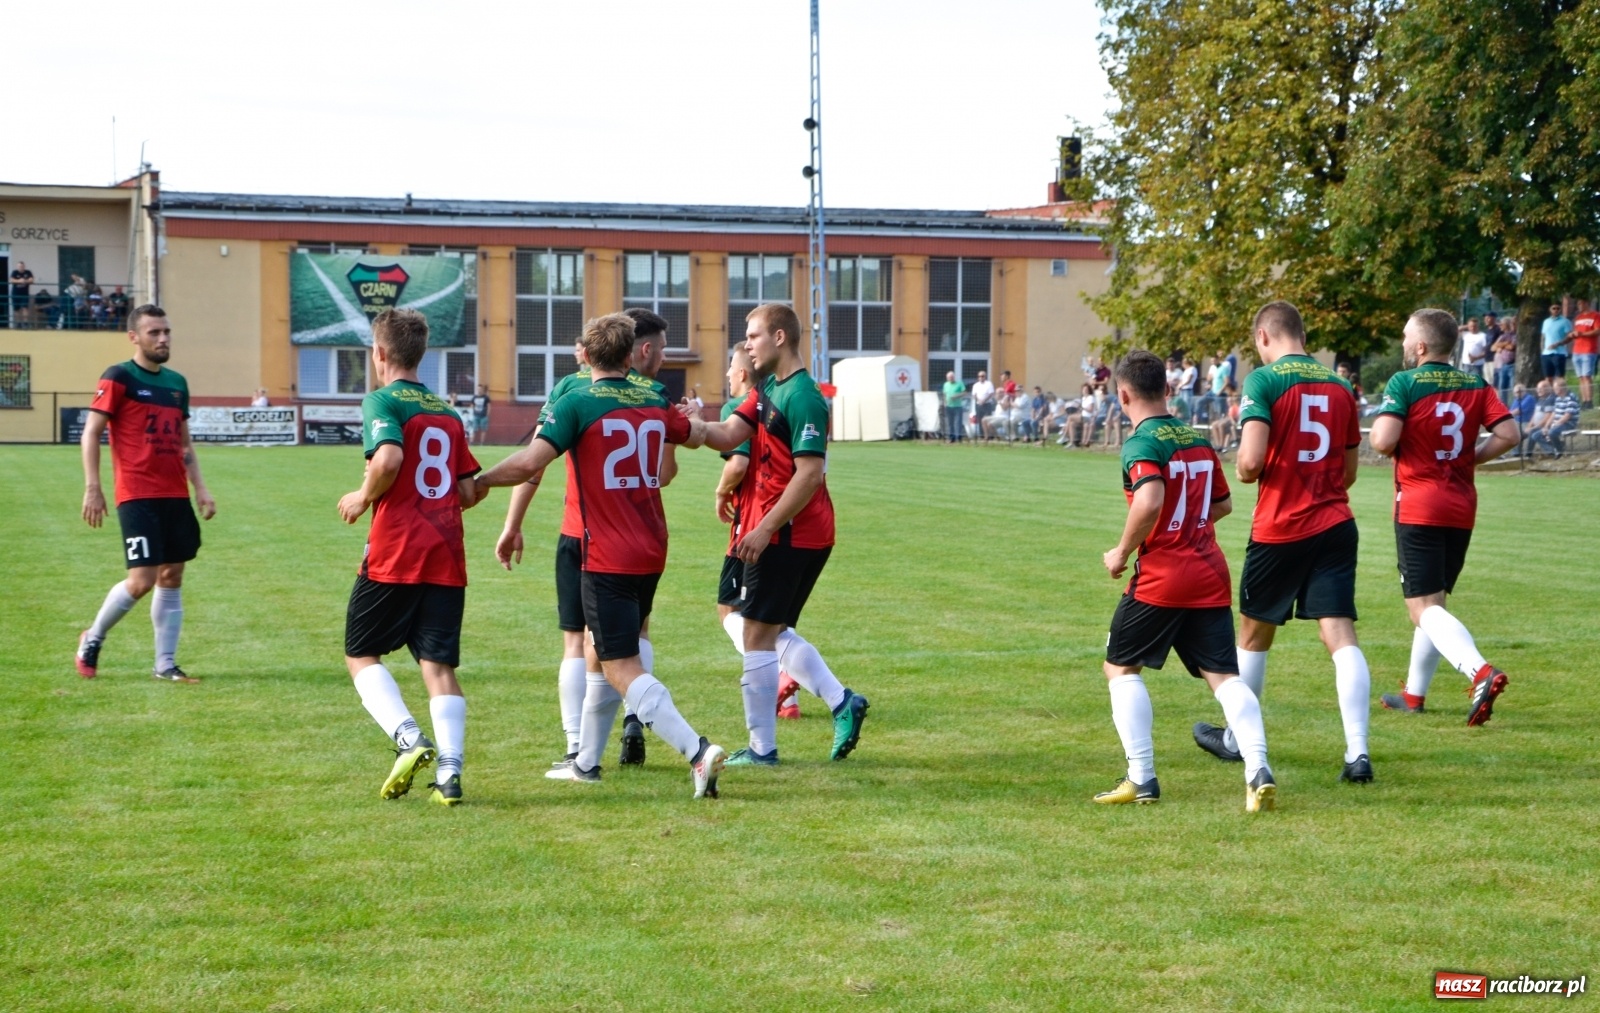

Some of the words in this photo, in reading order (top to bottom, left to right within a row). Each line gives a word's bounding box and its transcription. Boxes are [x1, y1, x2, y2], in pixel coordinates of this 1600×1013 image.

[11, 227, 70, 241] GORZYCE
[360, 283, 398, 298] CZARNI
[235, 411, 293, 421] GEODEZJA
[1298, 393, 1330, 463] 5
[1435, 401, 1465, 460] 3
[415, 426, 452, 499] 8
[602, 418, 666, 489] 20
[1167, 459, 1214, 531] 77
[126, 536, 150, 561] 27
